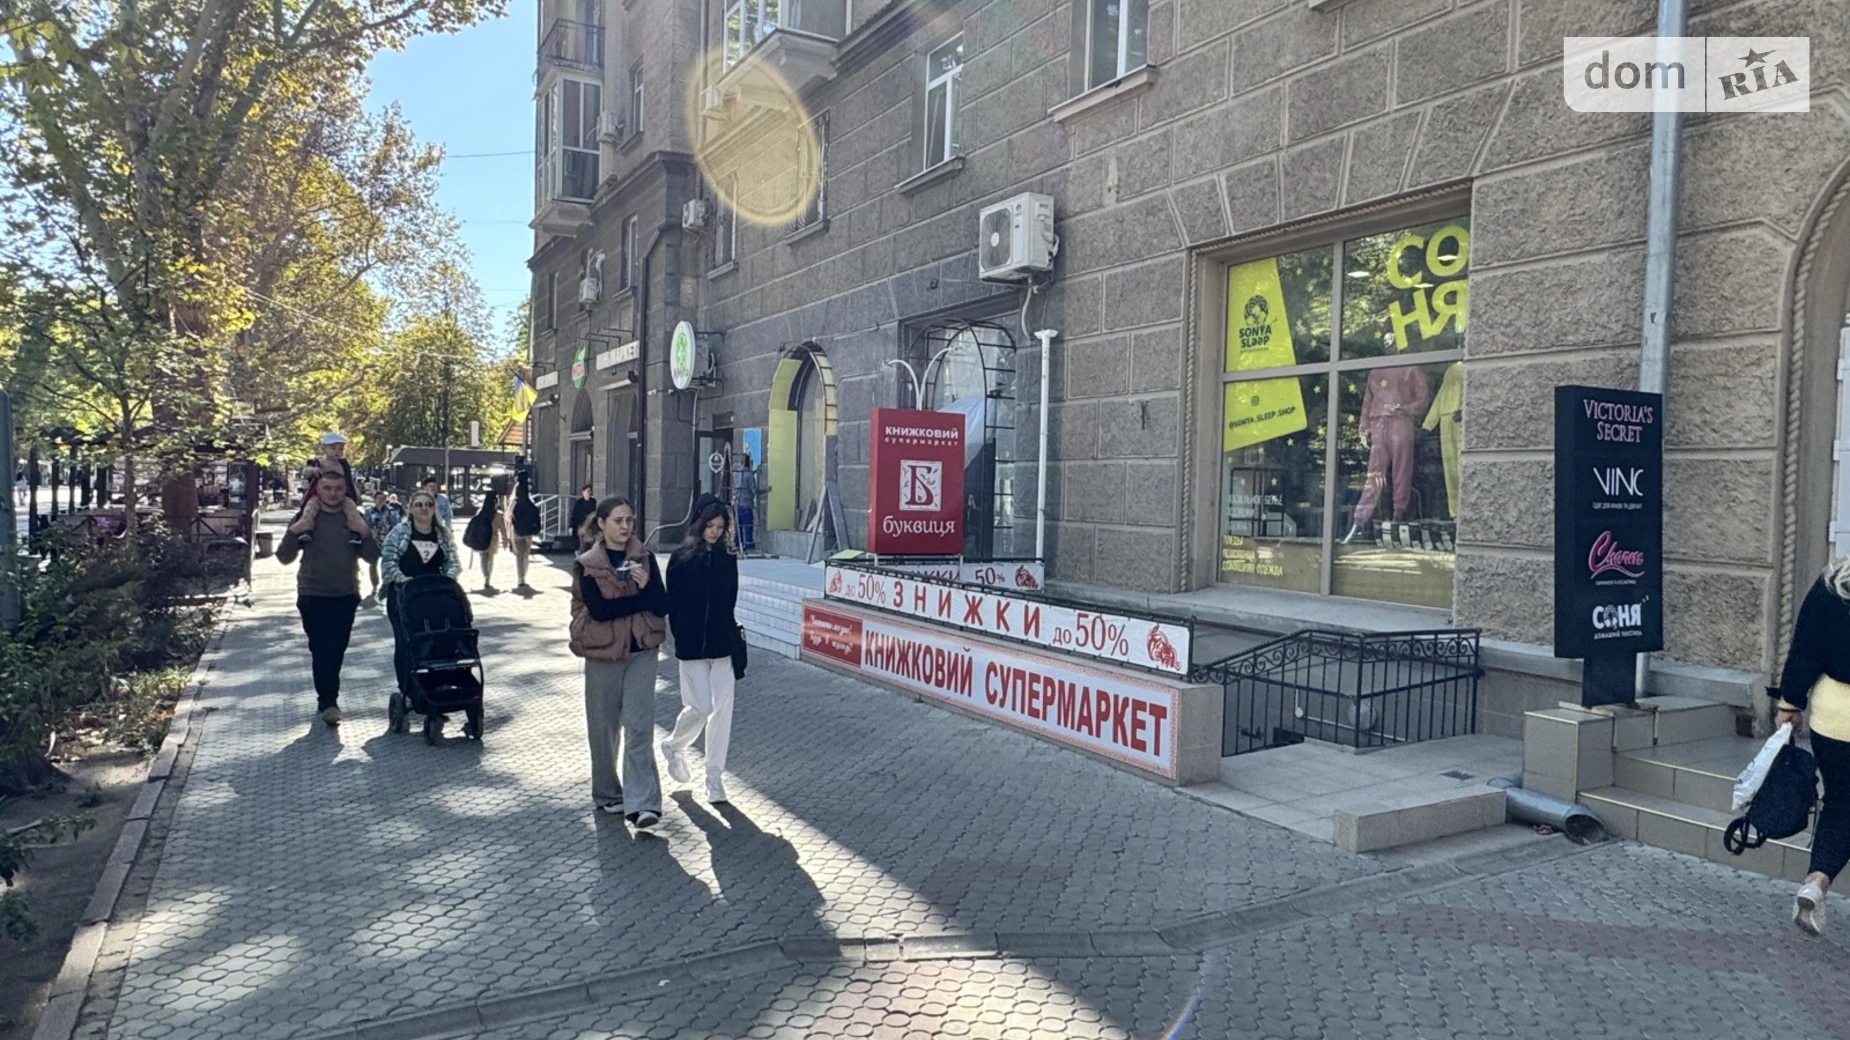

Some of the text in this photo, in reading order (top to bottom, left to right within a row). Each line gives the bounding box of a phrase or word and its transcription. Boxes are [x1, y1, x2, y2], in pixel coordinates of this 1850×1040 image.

[1239, 325, 1272, 339] SONYA
[1583, 399, 1653, 424] VICTORIA'S
[885, 426, 959, 440] КНИЖКОВИЙ
[885, 437, 959, 447] супермаркет
[1597, 421, 1643, 443] SECRET
[905, 465, 934, 506] Б
[1593, 467, 1644, 496] VINC
[882, 515, 956, 538] буквиця
[858, 574, 886, 604] 50%
[1053, 627, 1072, 645] до
[1075, 612, 1129, 656] 50%
[865, 630, 1167, 757] КНИЖКОВИЙ СУПЕРМАРКЕТ
